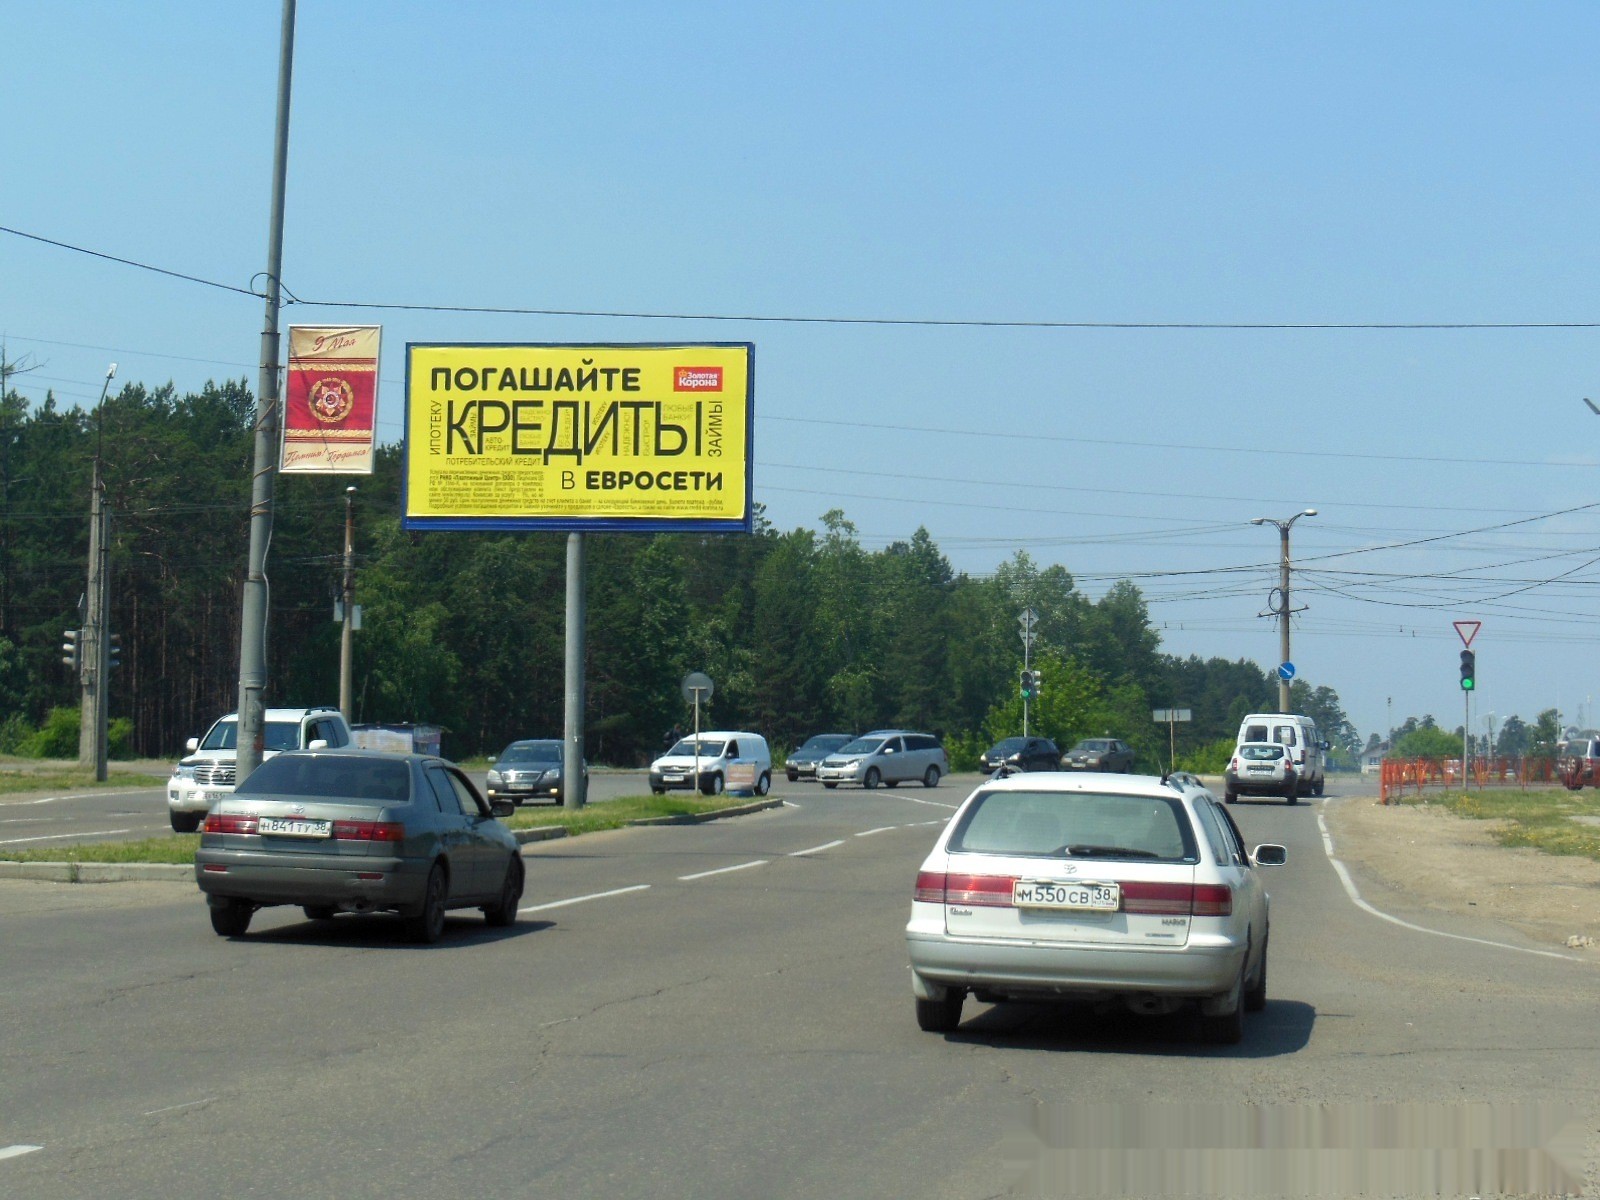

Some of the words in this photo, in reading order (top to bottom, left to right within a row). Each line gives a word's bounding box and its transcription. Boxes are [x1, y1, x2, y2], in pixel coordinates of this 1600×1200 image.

[431, 358, 641, 392] ПОГАШАЙТЕ
[679, 377, 718, 389] Корона
[687, 371, 718, 380] Золотая
[430, 400, 442, 455] ИПОТЕКУ
[446, 400, 702, 466] КРЕДИТЫ
[706, 400, 723, 457] ЗАЙМЫ
[446, 456, 513, 466] ПОТРЕБИТЕЛЬСКИЙ
[515, 457, 542, 467] КРЕДИТ
[562, 471, 575, 490] В
[585, 470, 723, 491] ЕВРОСЕТИ
[1094, 887, 1111, 900] 38
